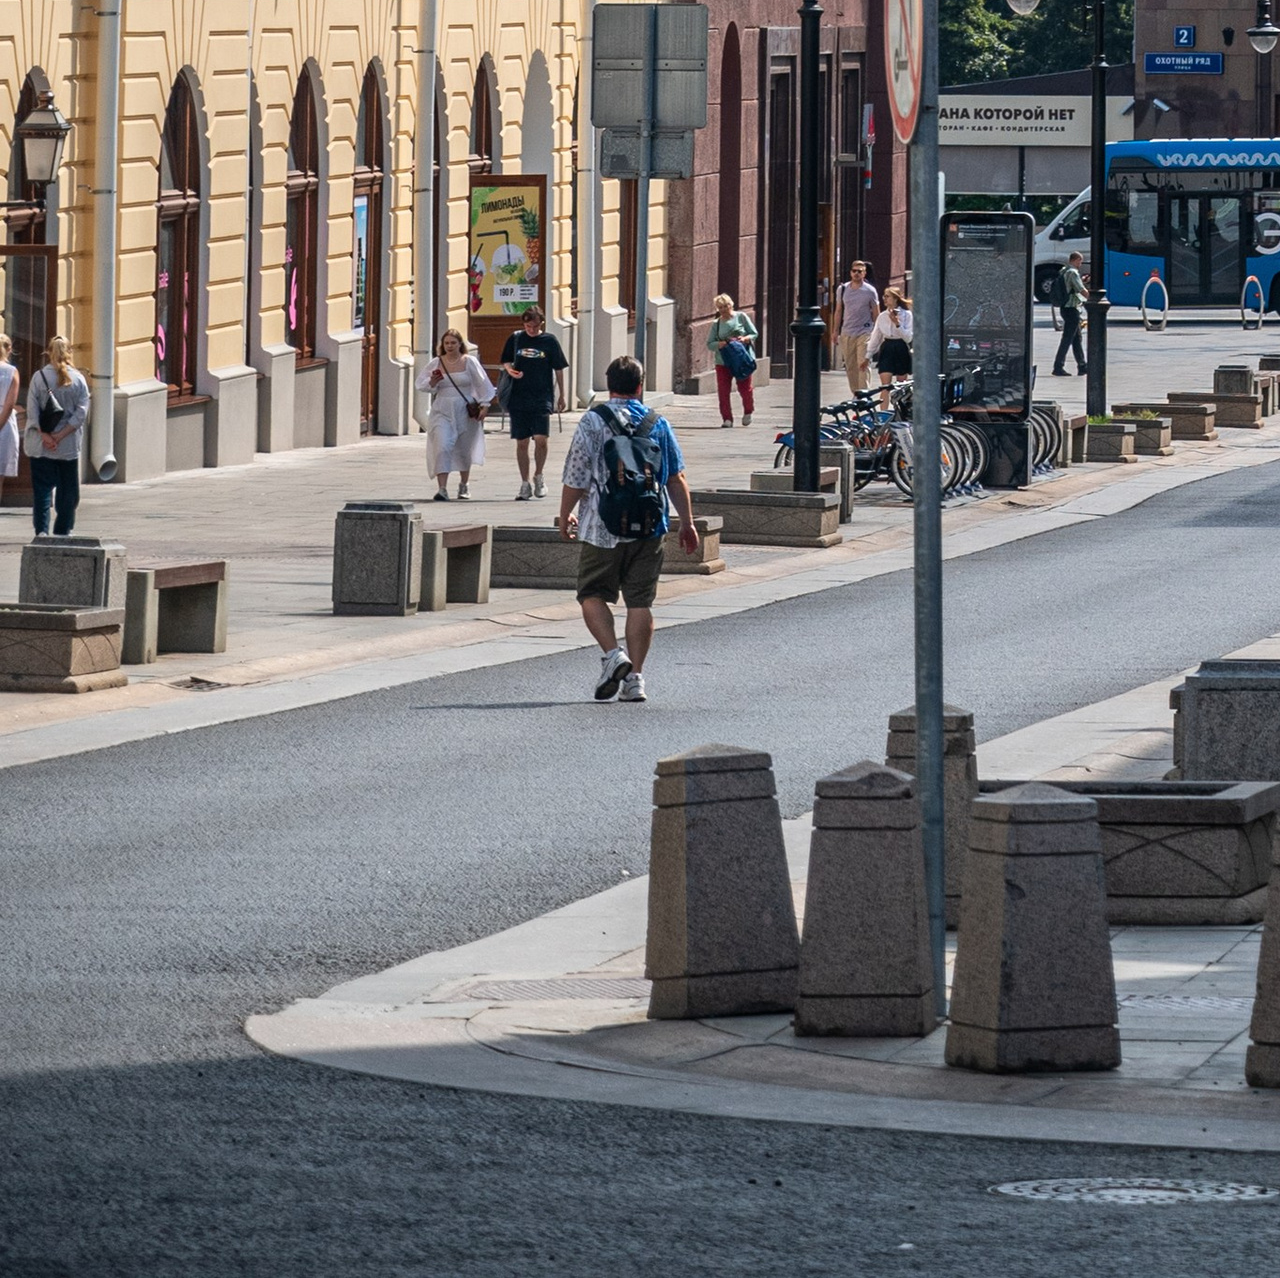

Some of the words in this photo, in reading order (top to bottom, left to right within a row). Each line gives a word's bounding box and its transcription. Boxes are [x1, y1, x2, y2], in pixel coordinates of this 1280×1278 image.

[1179, 29, 1188, 43] 2
[1155, 55, 1194, 65] ОХОТНЫЙ
[1195, 57, 1211, 66] РЯД
[973, 106, 1045, 121] КОТОРОЙ
[1048, 108, 1076, 121] НЕТ
[481, 195, 525, 214] ЛИМОНАДЫ
[498, 287, 509, 297] 190
